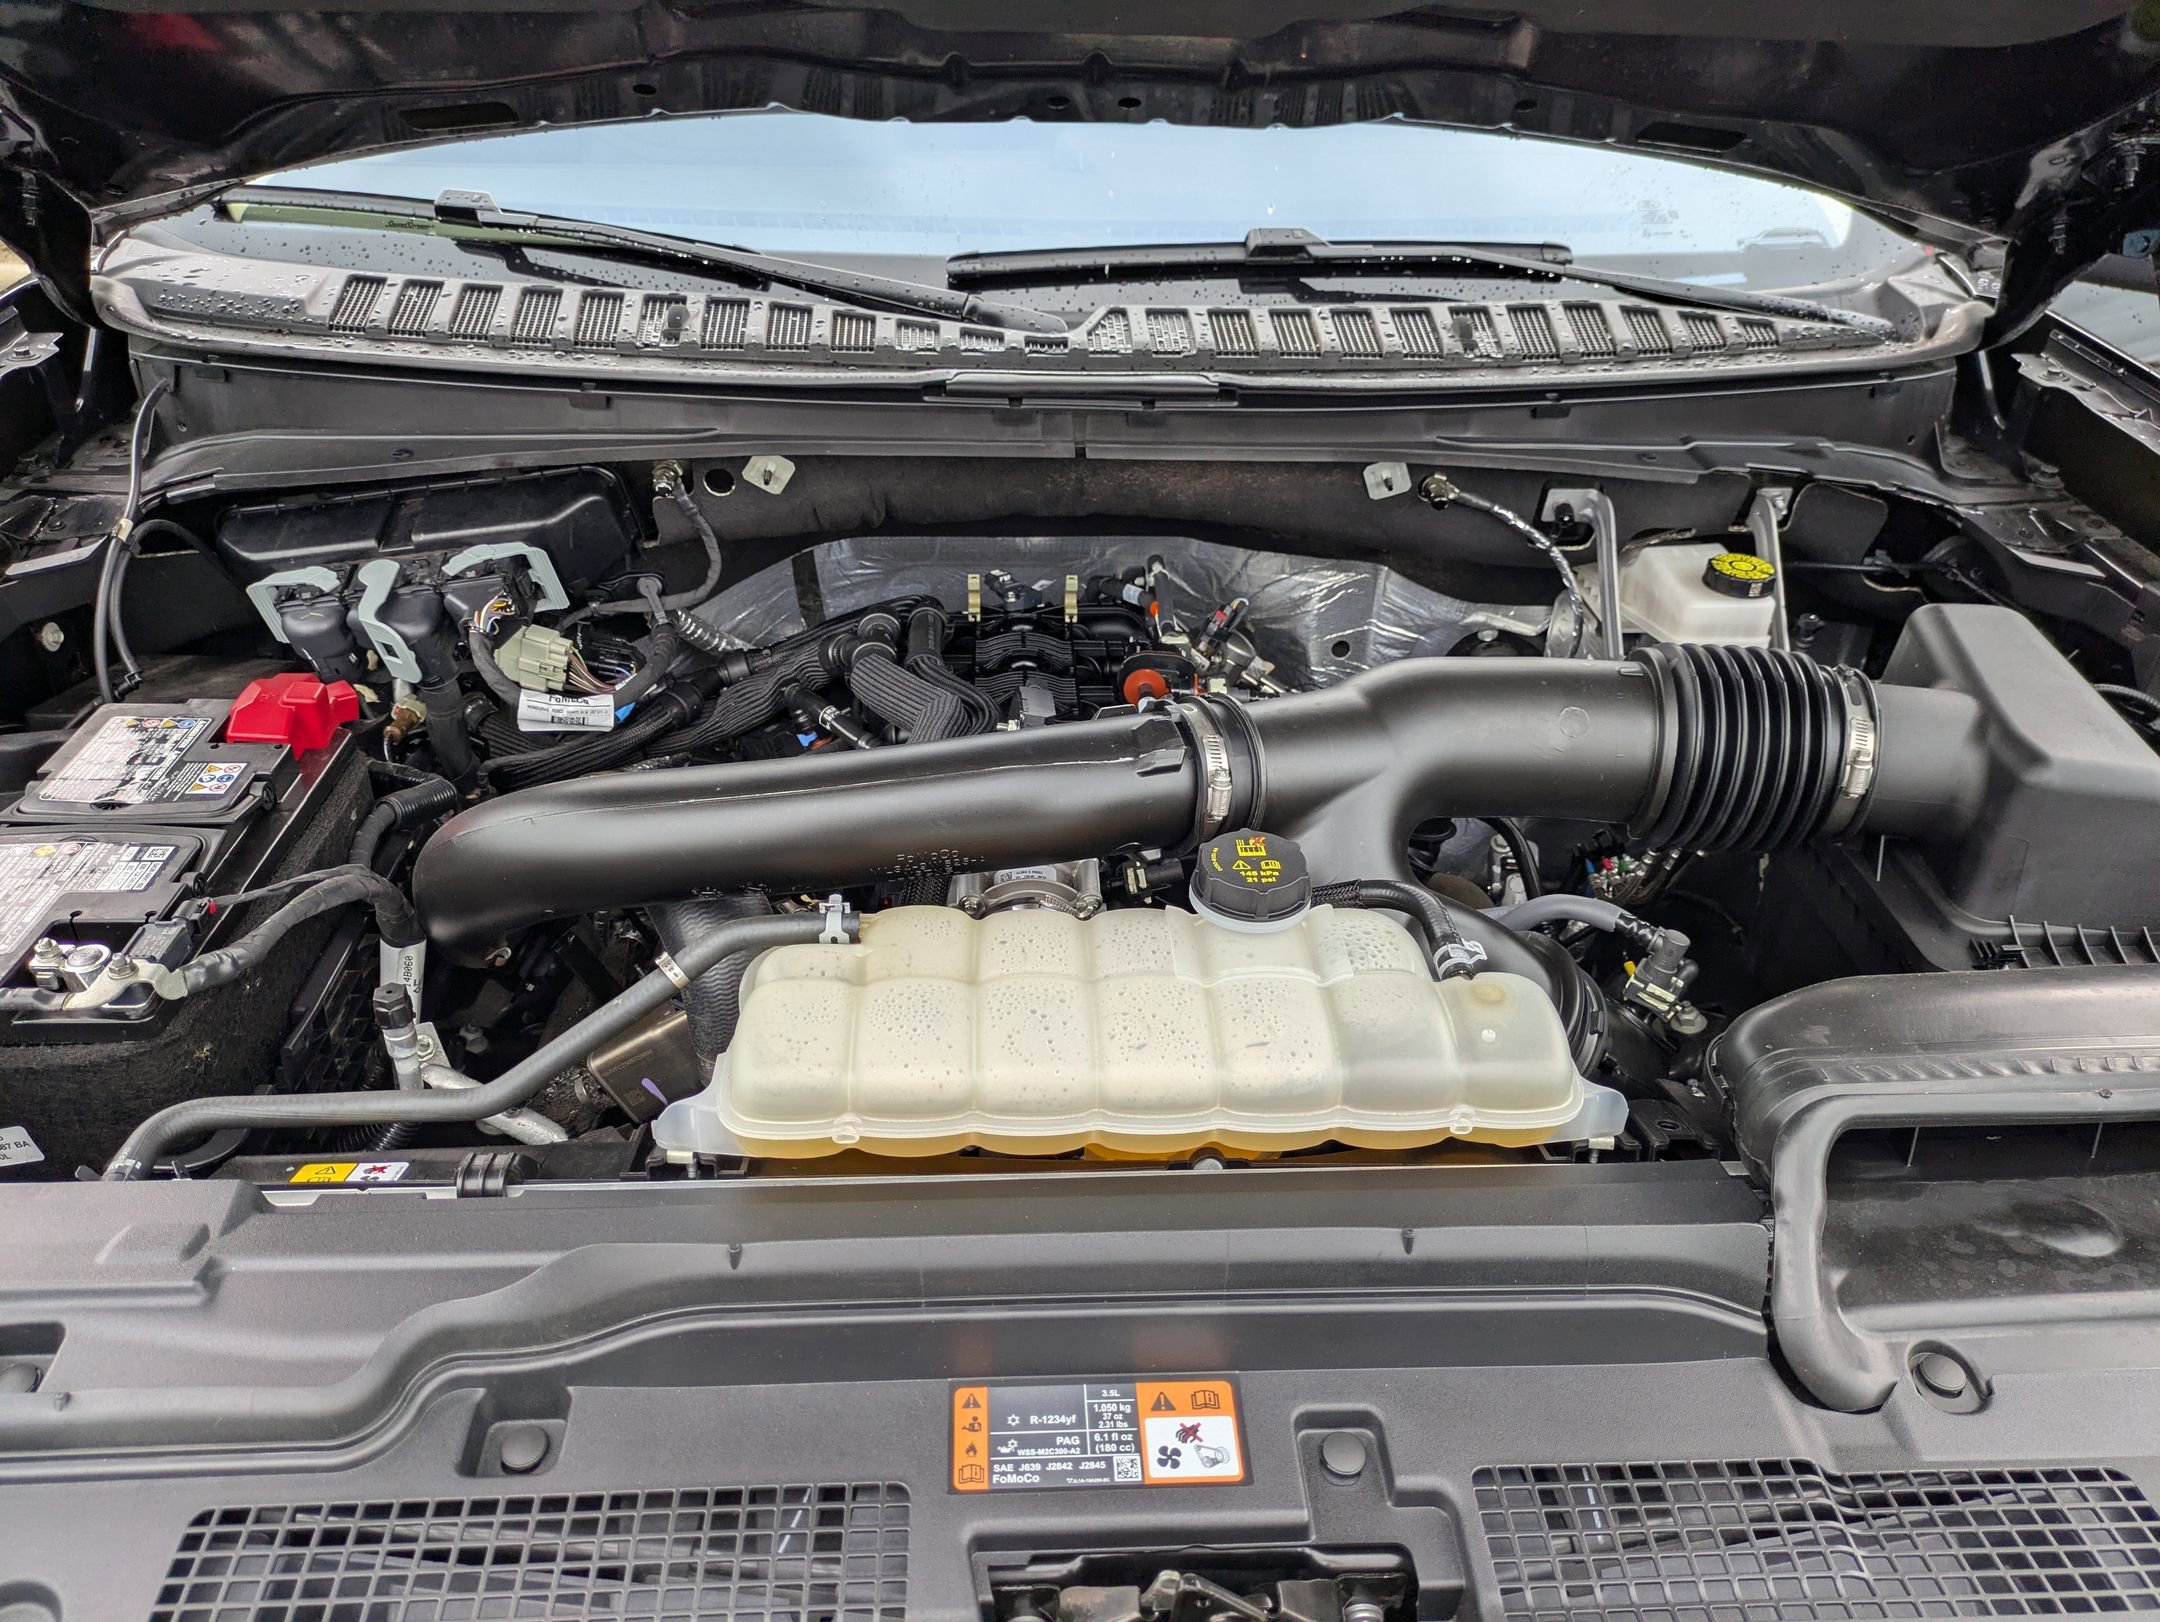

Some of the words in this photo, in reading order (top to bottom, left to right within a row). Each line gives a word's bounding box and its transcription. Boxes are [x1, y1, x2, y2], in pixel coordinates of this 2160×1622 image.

[14, 1141, 31, 1149] BA
[1101, 1389, 1120, 1397] 3.5L
[1093, 1403, 1117, 1412] 1.050
[1119, 1403, 1131, 1413] kg
[1029, 1414, 1076, 1426] R-1234yf
[1116, 1420, 1128, 1428] lbs
[1056, 1436, 1080, 1445] PAG
[1094, 1433, 1108, 1441] 6.1
[1095, 1444, 1117, 1453] (180
[1119, 1443, 1135, 1453] cc)
[993, 1463, 1014, 1472] SAE
[1018, 1463, 1041, 1472] J639
[1045, 1462, 1073, 1471] J2842
[1078, 1461, 1106, 1470] J2845
[992, 1473, 1040, 1484] FoMoCo
